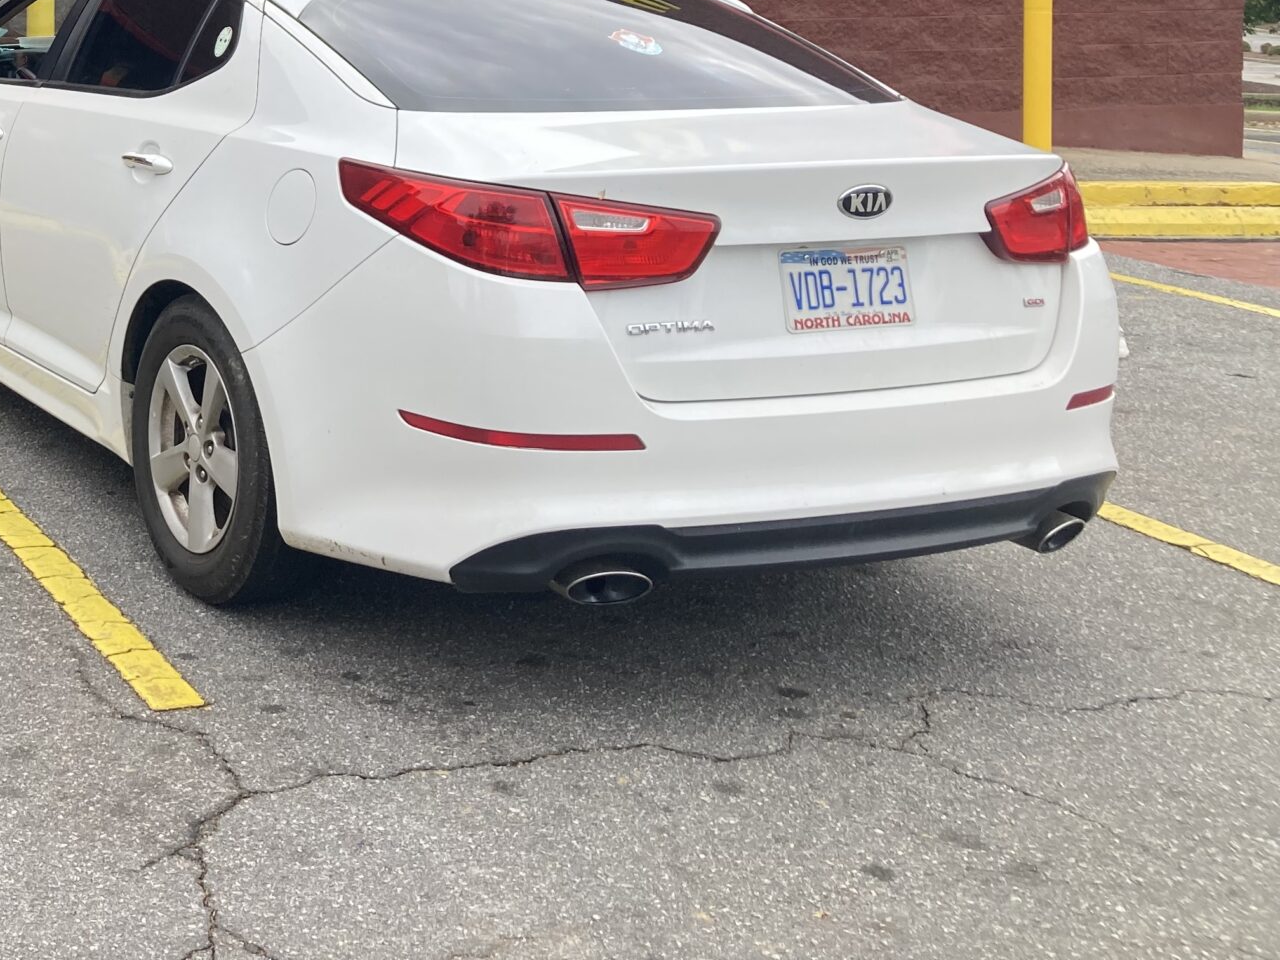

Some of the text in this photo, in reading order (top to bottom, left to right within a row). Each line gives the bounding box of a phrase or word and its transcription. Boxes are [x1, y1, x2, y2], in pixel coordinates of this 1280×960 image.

[849, 192, 887, 213] KIA
[809, 254, 879, 267] IN GOD WE TRUST
[789, 266, 908, 311] VDB-1723
[626, 320, 715, 336] OPTIMA
[794, 312, 911, 330] NORTH CAROLINA
